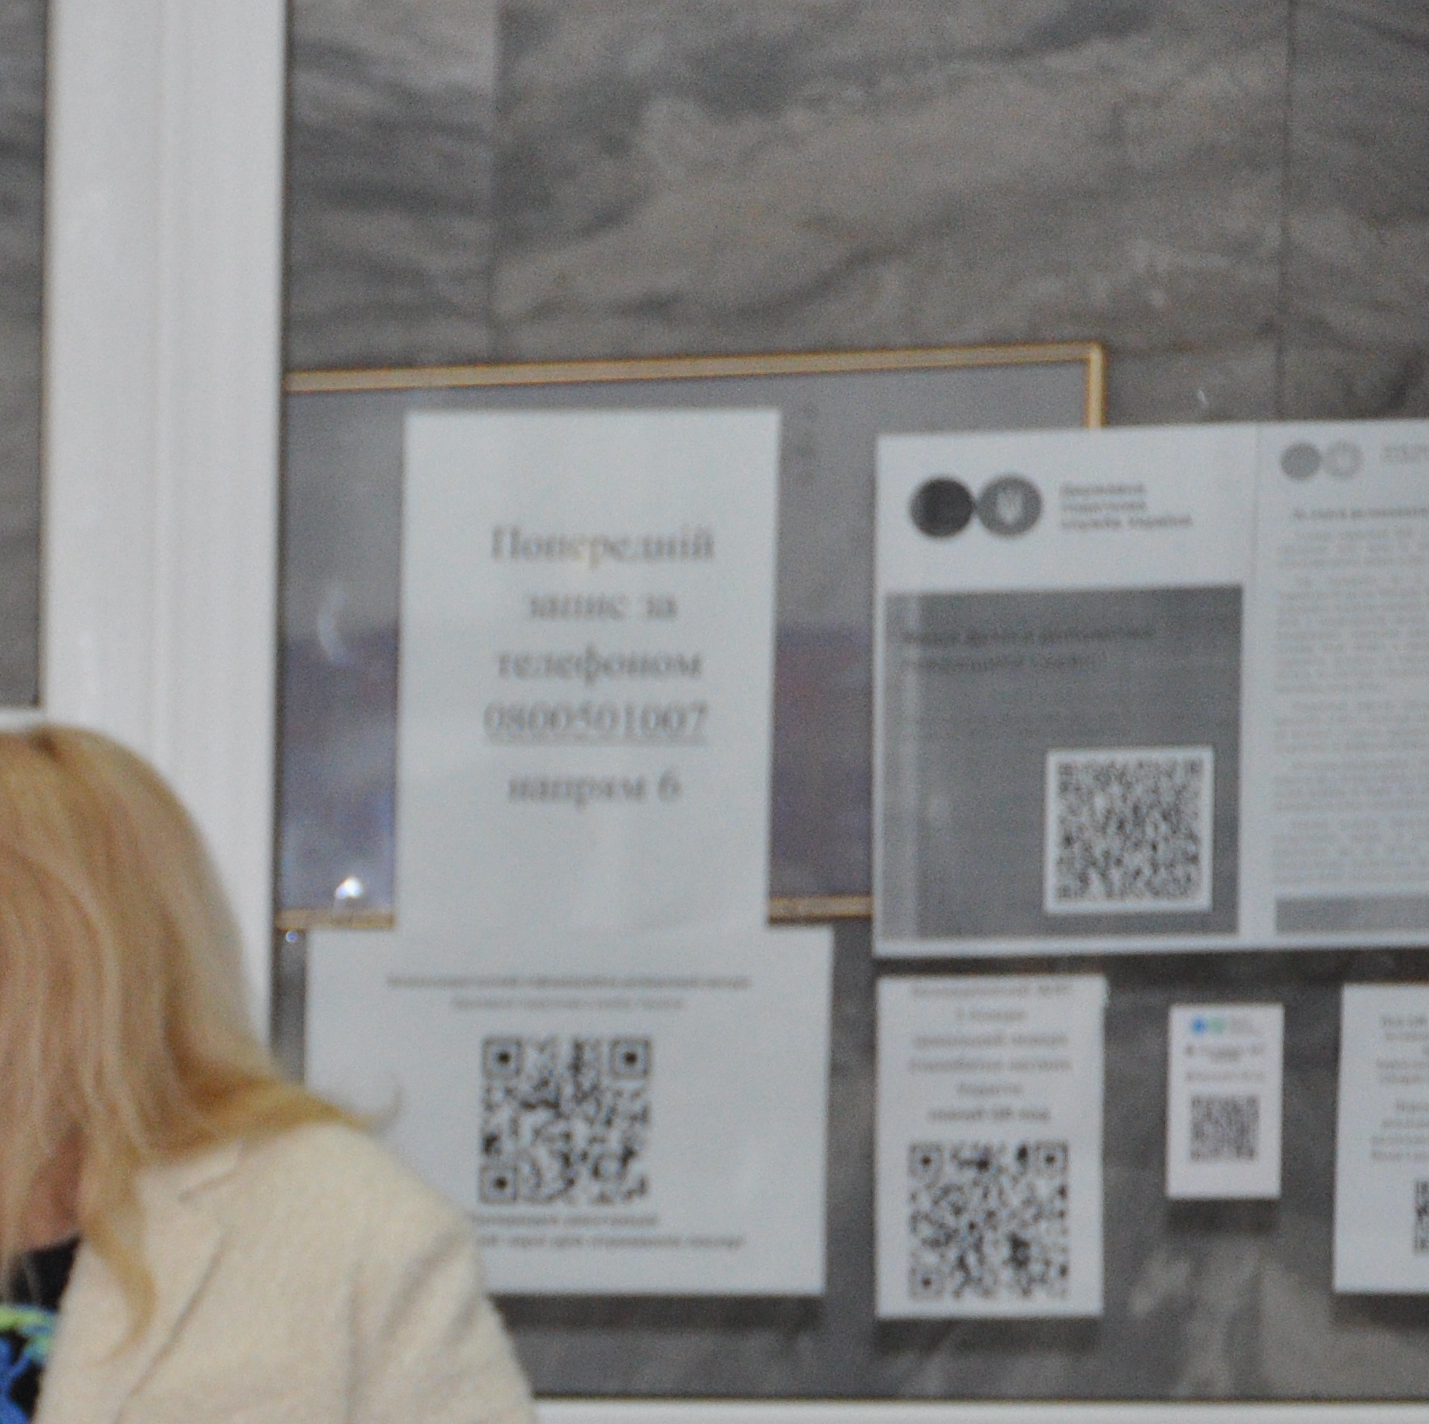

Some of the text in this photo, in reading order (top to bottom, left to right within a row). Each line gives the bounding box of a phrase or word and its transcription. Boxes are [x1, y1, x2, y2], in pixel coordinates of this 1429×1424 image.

[491, 525, 715, 570] Попередній
[527, 592, 678, 621] запис за
[497, 643, 702, 687] телефоном
[483, 699, 709, 742] 0800501007
[507, 767, 682, 813] напрям 6
